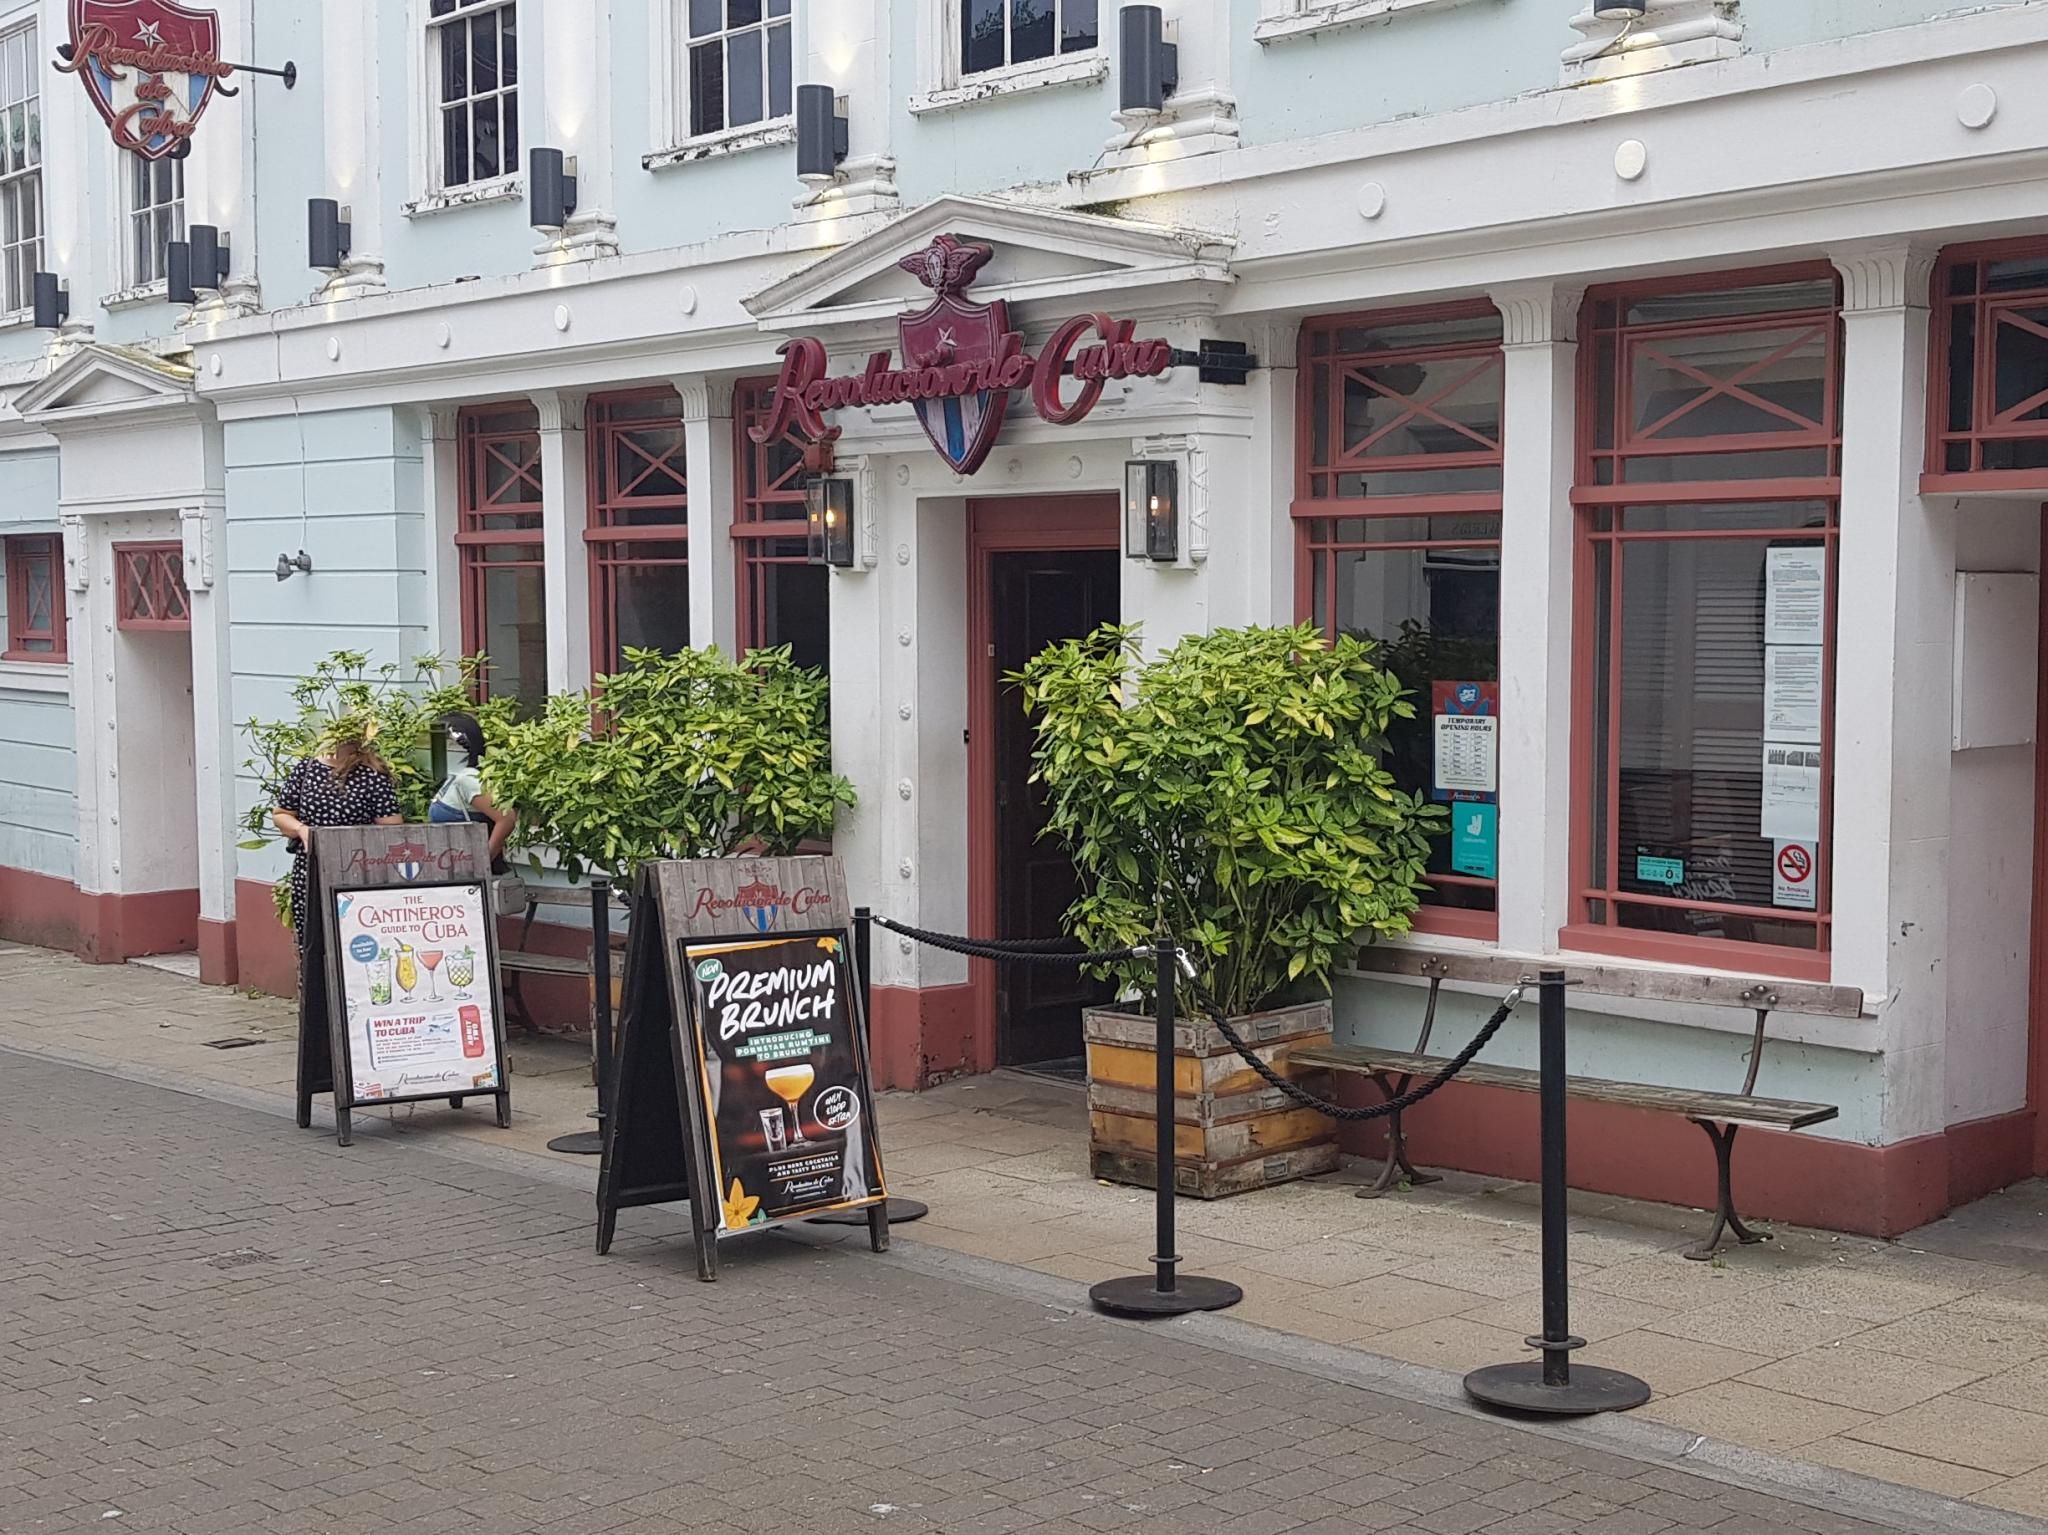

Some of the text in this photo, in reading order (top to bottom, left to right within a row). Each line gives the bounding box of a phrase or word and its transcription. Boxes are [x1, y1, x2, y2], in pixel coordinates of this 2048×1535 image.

[135, 73, 174, 100] de
[111, 101, 196, 150] Cuba
[977, 330, 1035, 392] de
[1032, 312, 1170, 425] Cuba
[437, 847, 475, 871] Cuba
[403, 895, 424, 905] THE
[774, 890, 792, 907] de
[791, 886, 832, 916] Cuba
[358, 905, 465, 928] CANTINERO'S
[381, 921, 469, 943] GUIDE TO CUBA
[701, 961, 721, 978] NEW
[708, 959, 836, 1009] PREMIUM
[374, 1017, 394, 1028] WIN
[394, 1017, 402, 1026] A
[403, 1015, 427, 1025] TRIP
[719, 988, 836, 1041] BRUNCH
[389, 1027, 415, 1036] CUBA
[749, 1031, 813, 1046] INTRODUCING
[736, 1035, 831, 1055] PORNSTAR RUMTINI
[773, 1047, 810, 1058] BRUNCH
[825, 1091, 843, 1106] ONLY
[828, 1112, 851, 1126] EXTRA
[768, 1165, 786, 1173] PLUS
[804, 1155, 840, 1166] COCKTAILS
[792, 1166, 810, 1175] TASTY
